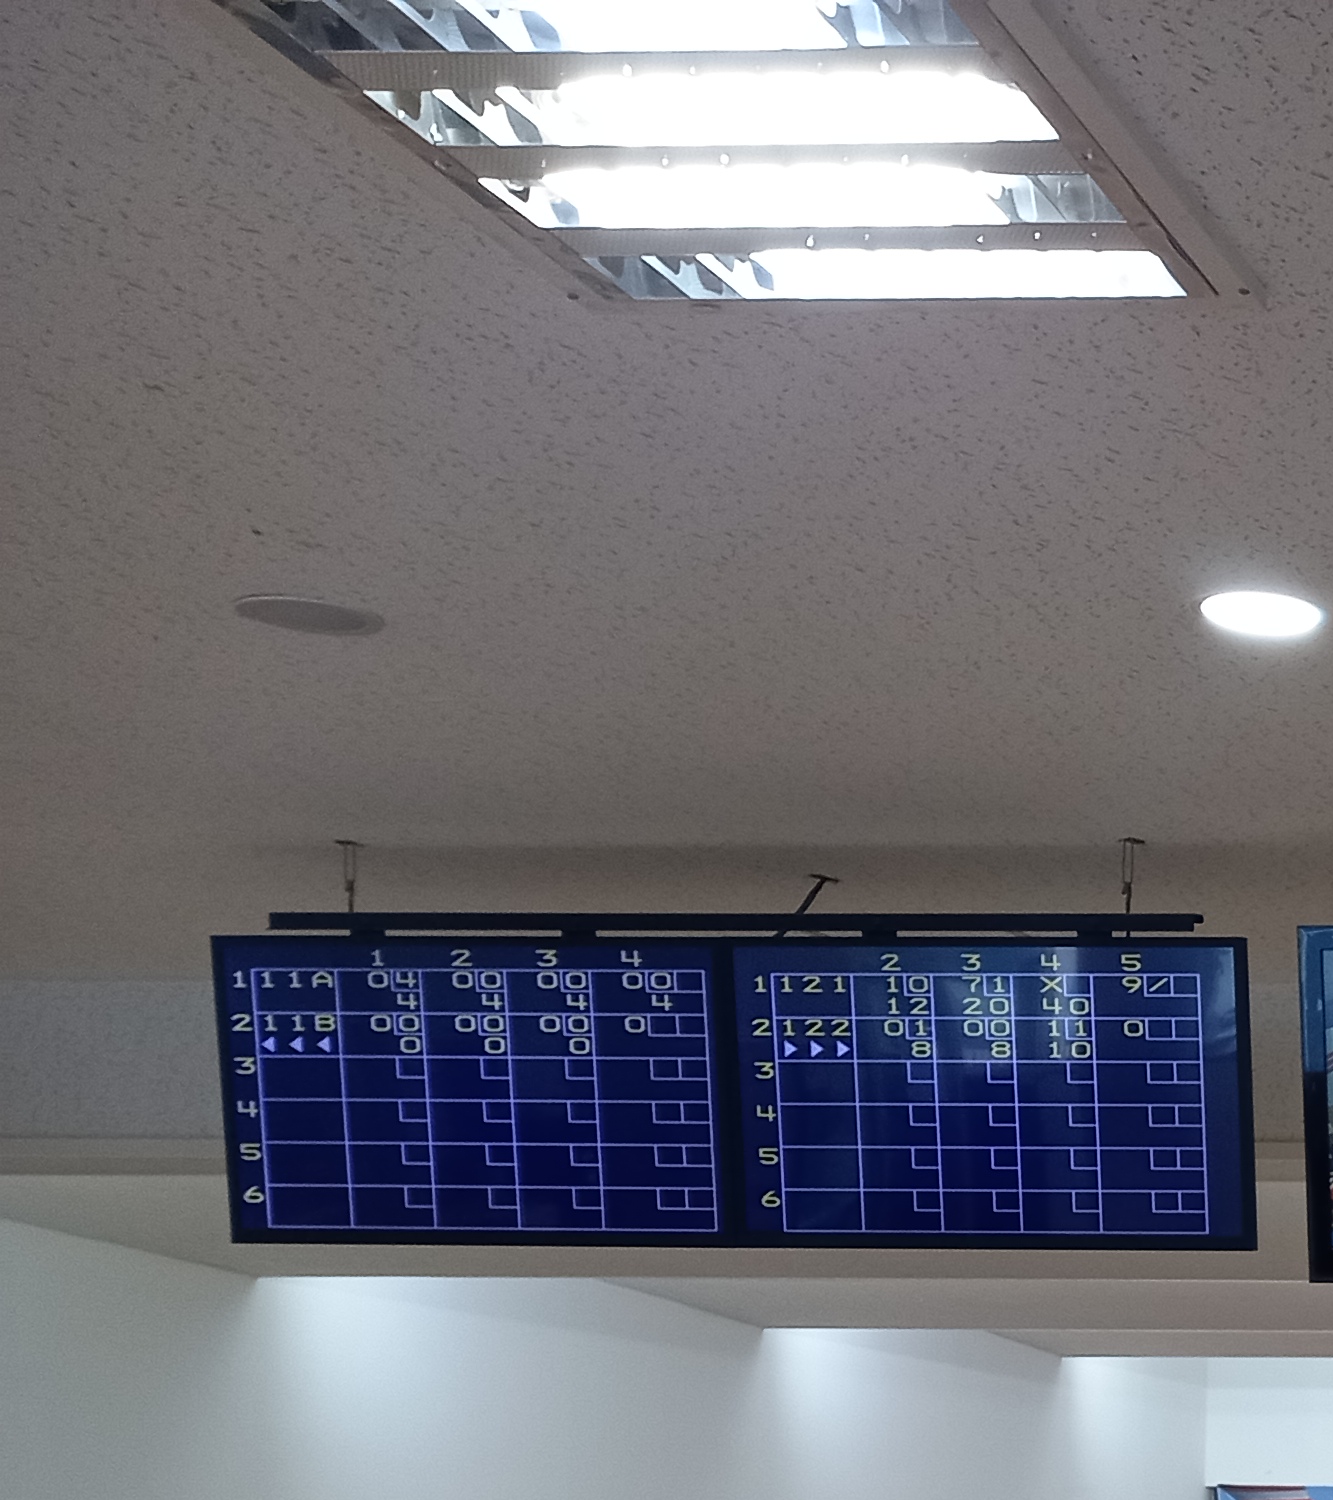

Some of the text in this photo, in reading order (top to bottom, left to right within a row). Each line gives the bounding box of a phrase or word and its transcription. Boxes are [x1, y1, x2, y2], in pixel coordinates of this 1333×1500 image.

[369, 949, 643, 967] 1 2 3 4
[879, 953, 1142, 971] 2 3 4 5
[231, 971, 247, 988] 1
[752, 976, 767, 993] 1
[395, 993, 673, 1011] 4 4 4 4
[886, 997, 1091, 1015] 12 20 40
[230, 1014, 253, 1032] 2
[624, 1015, 646, 1033] 0
[751, 1019, 773, 1037] 2
[1121, 1019, 1144, 1038] 0
[399, 1036, 591, 1055] 0 0 0
[909, 1040, 1091, 1059] 8 8 10
[232, 1058, 257, 1075] 3
[752, 1062, 775, 1079] 3
[234, 1101, 259, 1118] 4
[755, 1105, 778, 1121] 4
[238, 1143, 263, 1161] 5
[758, 1148, 779, 1165] 5
[242, 1187, 266, 1204] 6
[760, 1190, 781, 1208] 6
